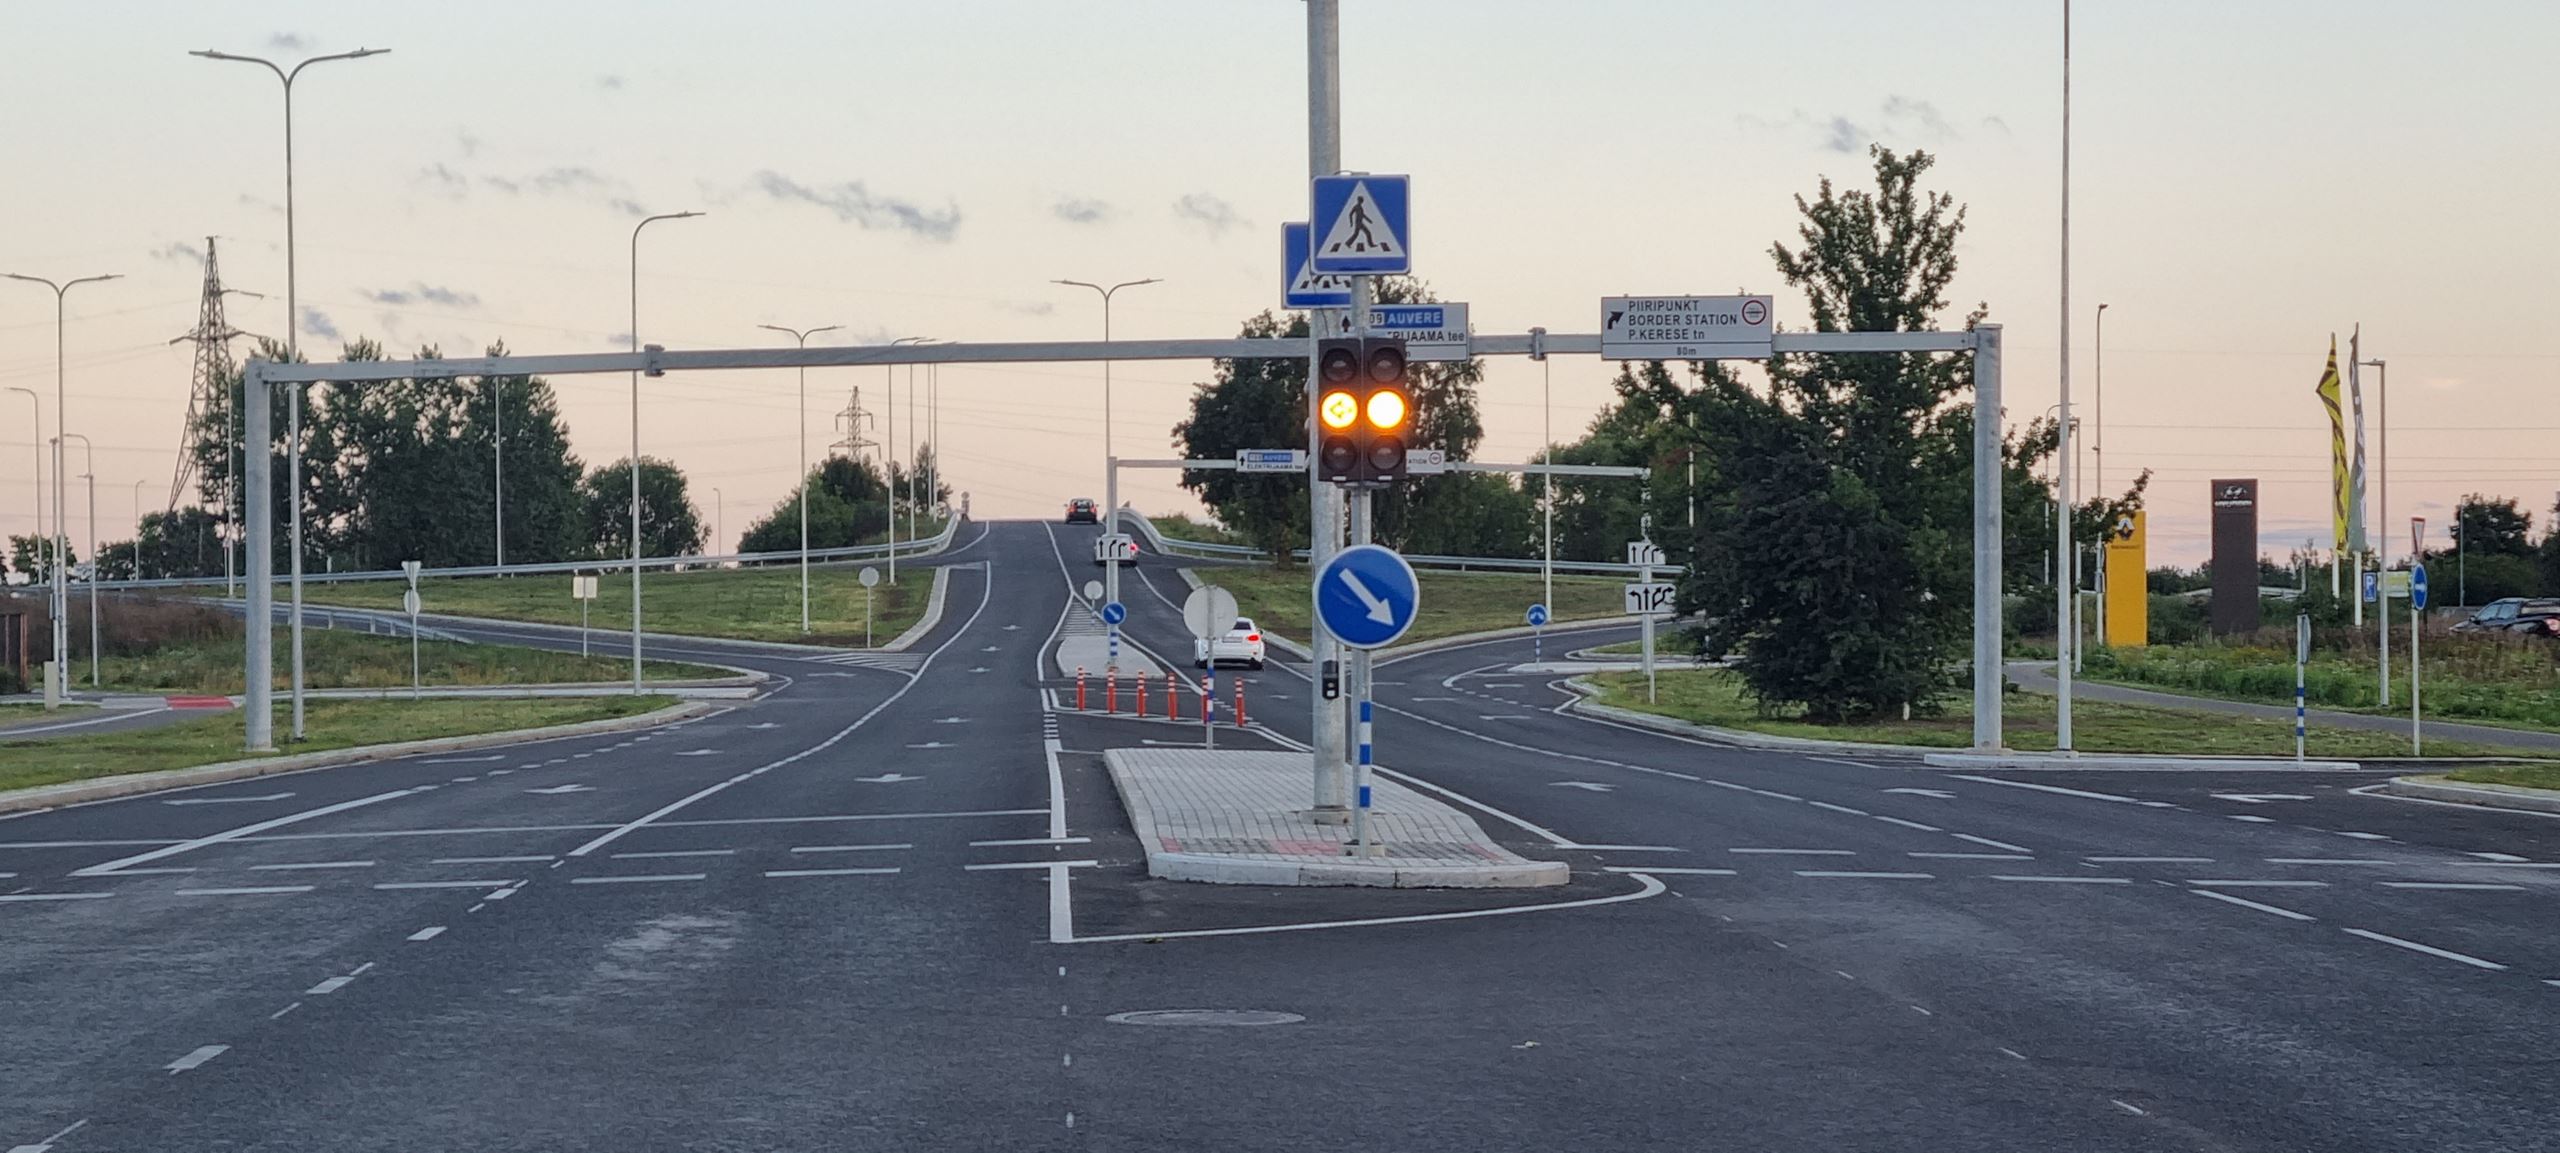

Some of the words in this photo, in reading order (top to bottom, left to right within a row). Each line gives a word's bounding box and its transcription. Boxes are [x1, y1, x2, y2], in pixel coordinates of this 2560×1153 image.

[1628, 300, 1699, 311] PIIRIPUNKT
[1387, 312, 1441, 324] AUVERE
[1628, 314, 1680, 326] BORDER
[1685, 313, 1738, 325] STATION
[1448, 331, 1465, 342] tee
[1628, 329, 1689, 340] P.KERESE
[1693, 329, 1705, 340] tn
